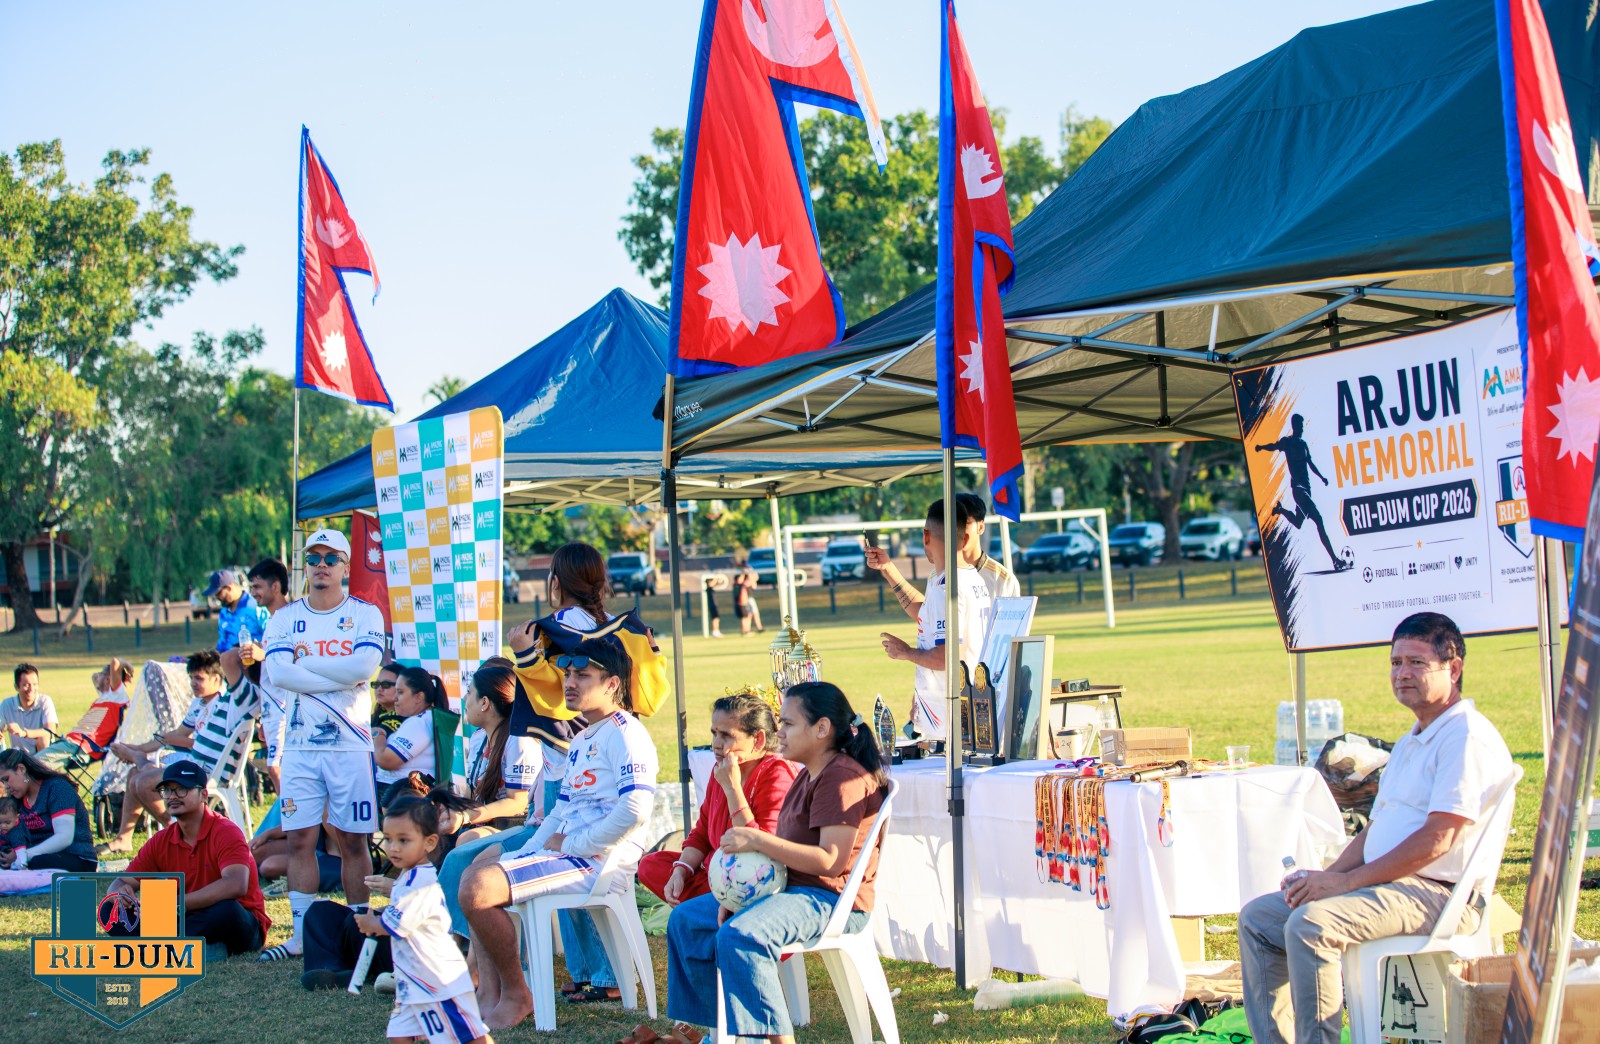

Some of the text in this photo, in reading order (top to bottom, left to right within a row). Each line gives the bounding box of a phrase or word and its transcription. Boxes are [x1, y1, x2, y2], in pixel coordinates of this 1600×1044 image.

[1504, 366, 1523, 385] AMA
[1336, 357, 1461, 437] ARJUN
[1331, 422, 1474, 489] MEMORIAL
[1350, 487, 1472, 530] RII-DUM CUP 2026
[1499, 502, 1529, 522] RII-D
[1375, 556, 1478, 578] FOOTBALL COMMUNITY UNITY
[1362, 602, 1381, 612] UNITED
[1382, 600, 1405, 609] THROUGH
[1433, 593, 1457, 604] STRONGER
[293, 620, 306, 634] 10
[314, 639, 353, 657] TCS
[512, 764, 535, 774] 2026
[620, 763, 647, 776] 2026
[352, 801, 371, 822] 10
[420, 1009, 445, 1037] 10
